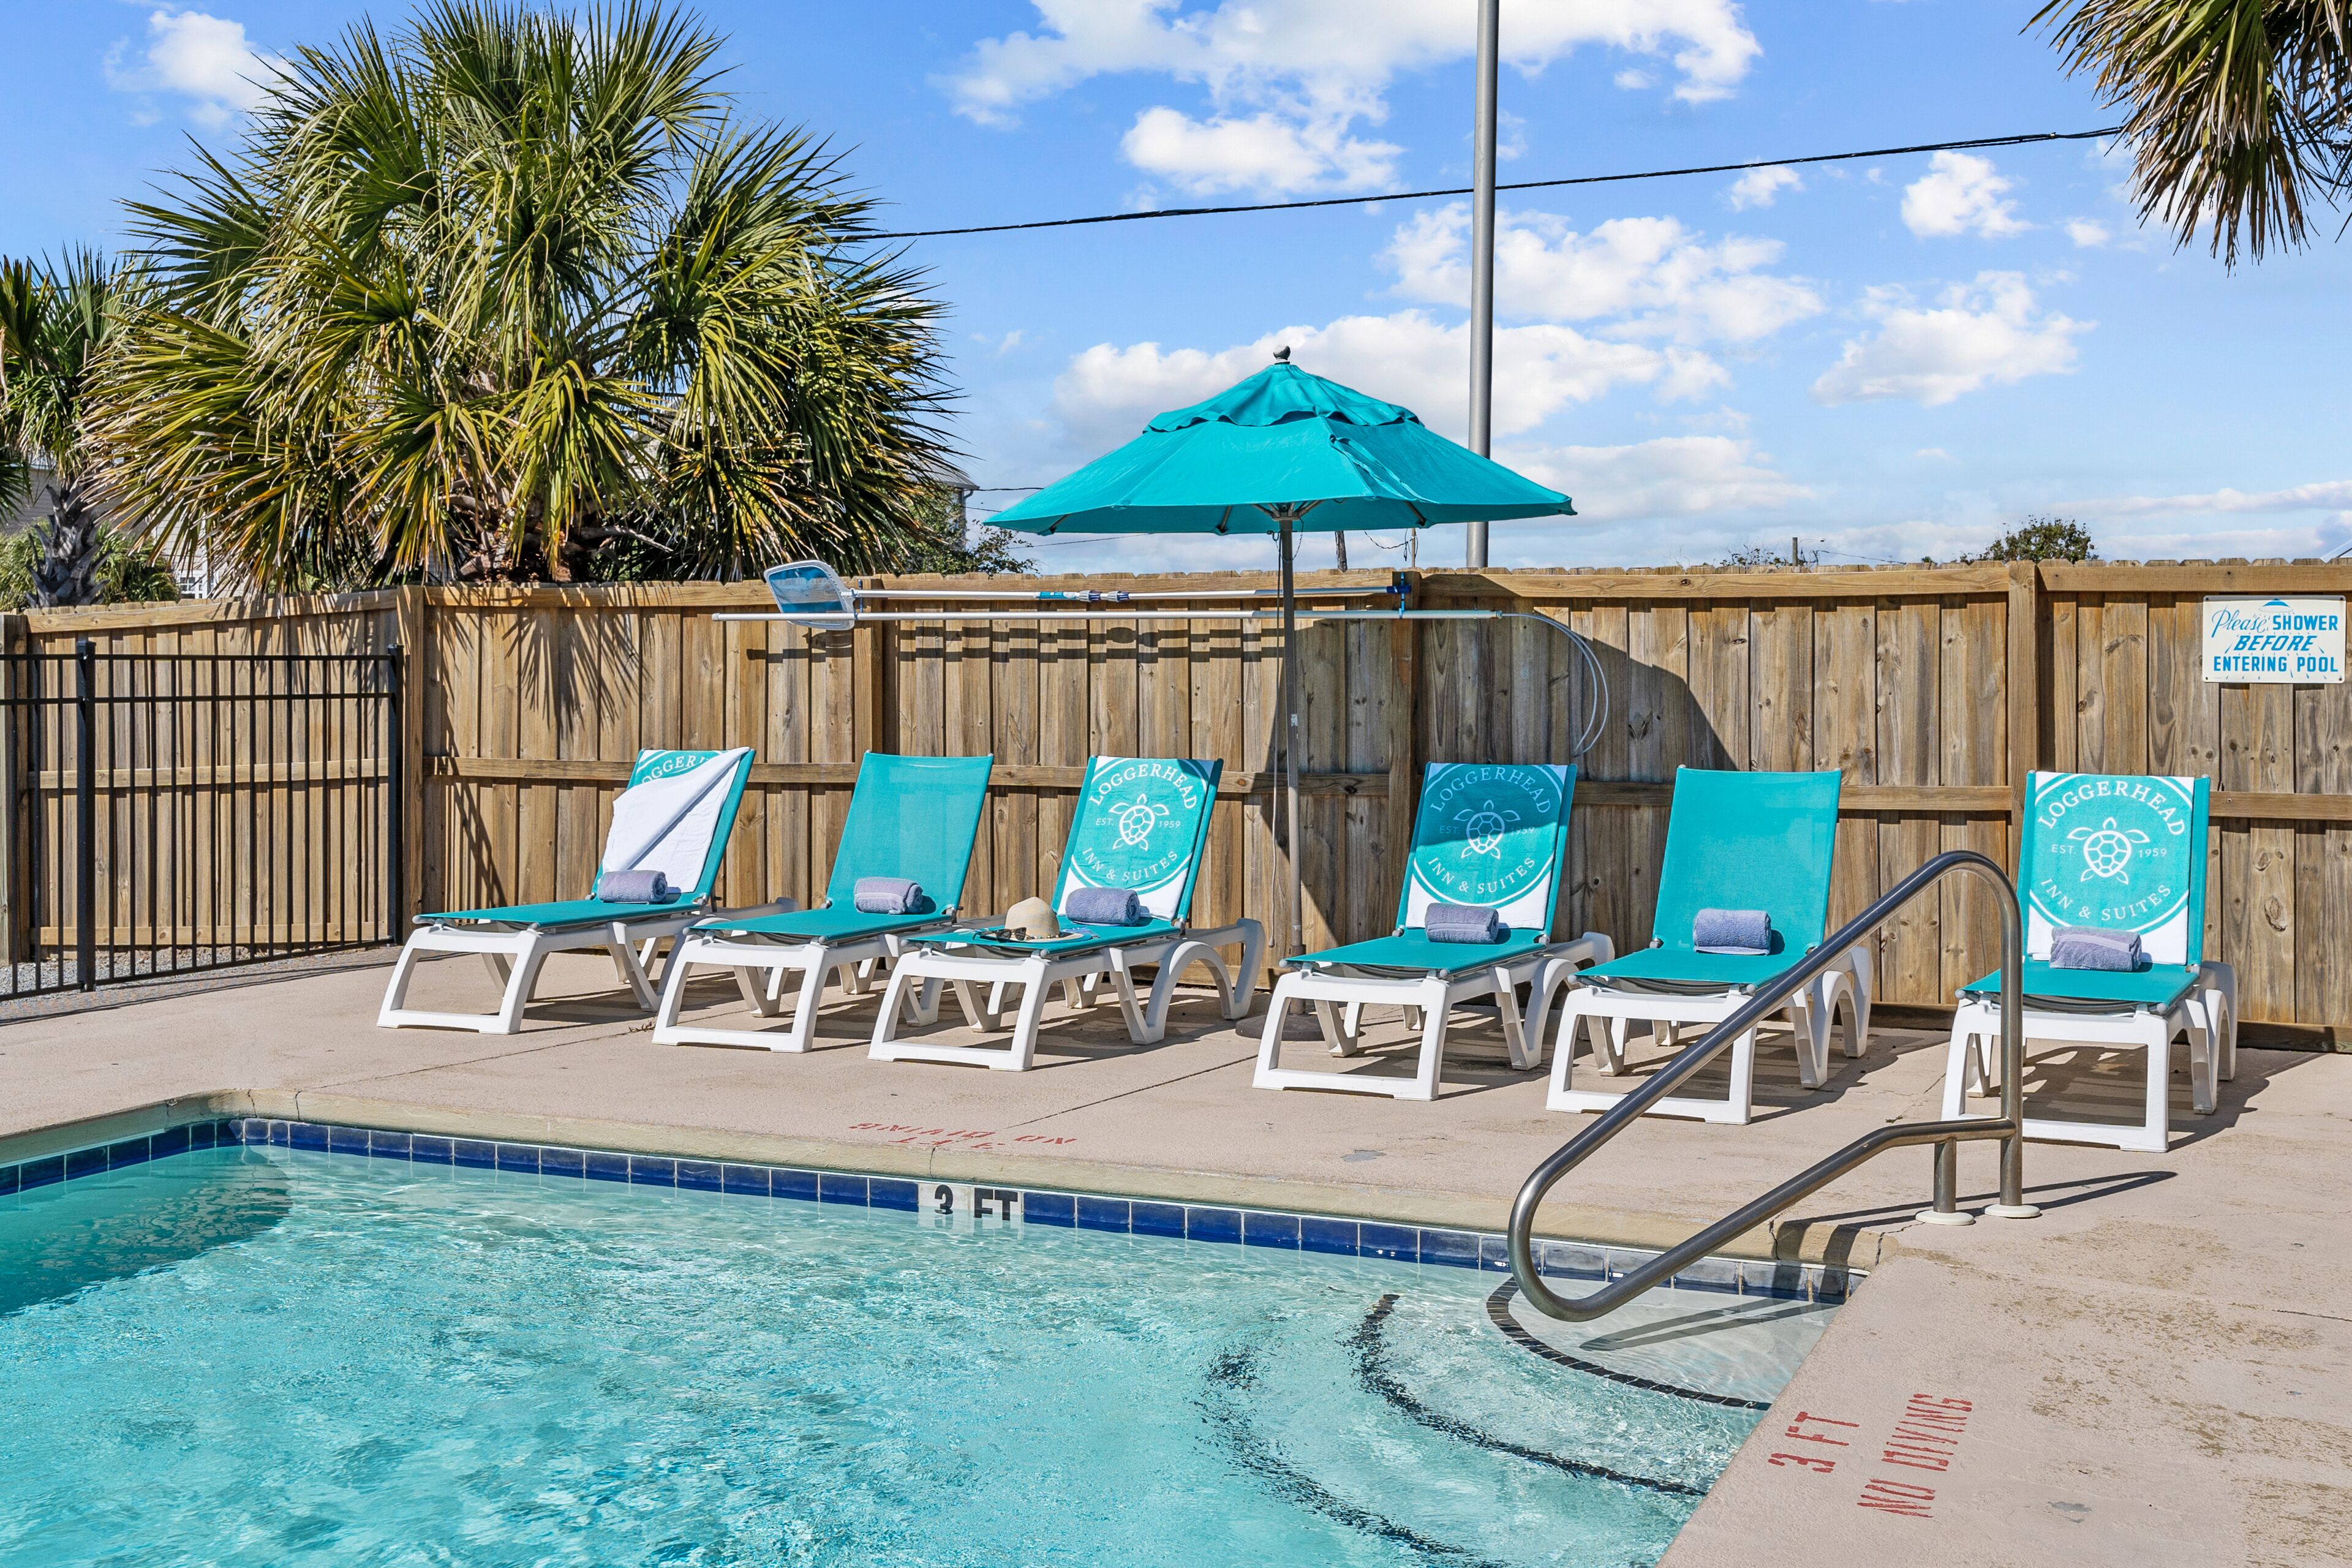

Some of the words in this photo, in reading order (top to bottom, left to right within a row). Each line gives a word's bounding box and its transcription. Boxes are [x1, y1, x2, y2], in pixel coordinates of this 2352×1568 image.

[2211, 605, 2267, 638] Please
[2272, 615, 2339, 630] SHOWER
[2234, 635, 2317, 651] BEFORE
[2214, 656, 2287, 672] ENTERING
[2297, 657, 2339, 672] POOL
[1088, 763, 1197, 809] LOGGERHEAD
[1430, 766, 1551, 813] LOGGERHEAD
[1095, 818, 1114, 826] EST.
[2038, 780, 2185, 837] LOGGERHEAD
[1439, 826, 1460, 834] EST.
[1083, 847, 1104, 872] INN
[1106, 869, 1117, 880] &
[1122, 850, 1177, 881] SUITES
[2052, 844, 2076, 855] EST.
[2138, 848, 2167, 858] 1959
[1428, 857, 1455, 885] INN
[1458, 881, 1469, 893] &
[1477, 858, 1536, 894] SUITES
[2041, 878, 2074, 910] INN
[2078, 906, 2092, 919] &
[2101, 884, 2171, 921] SUITES
[934, 1184, 954, 1215] 3
[974, 1187, 1019, 1221] FT
[1785, 1411, 1860, 1446] FT
[1881, 1393, 1973, 1472] DIVING
[1768, 1452, 1836, 1472] 3
[1856, 1477, 1936, 1518] NO
